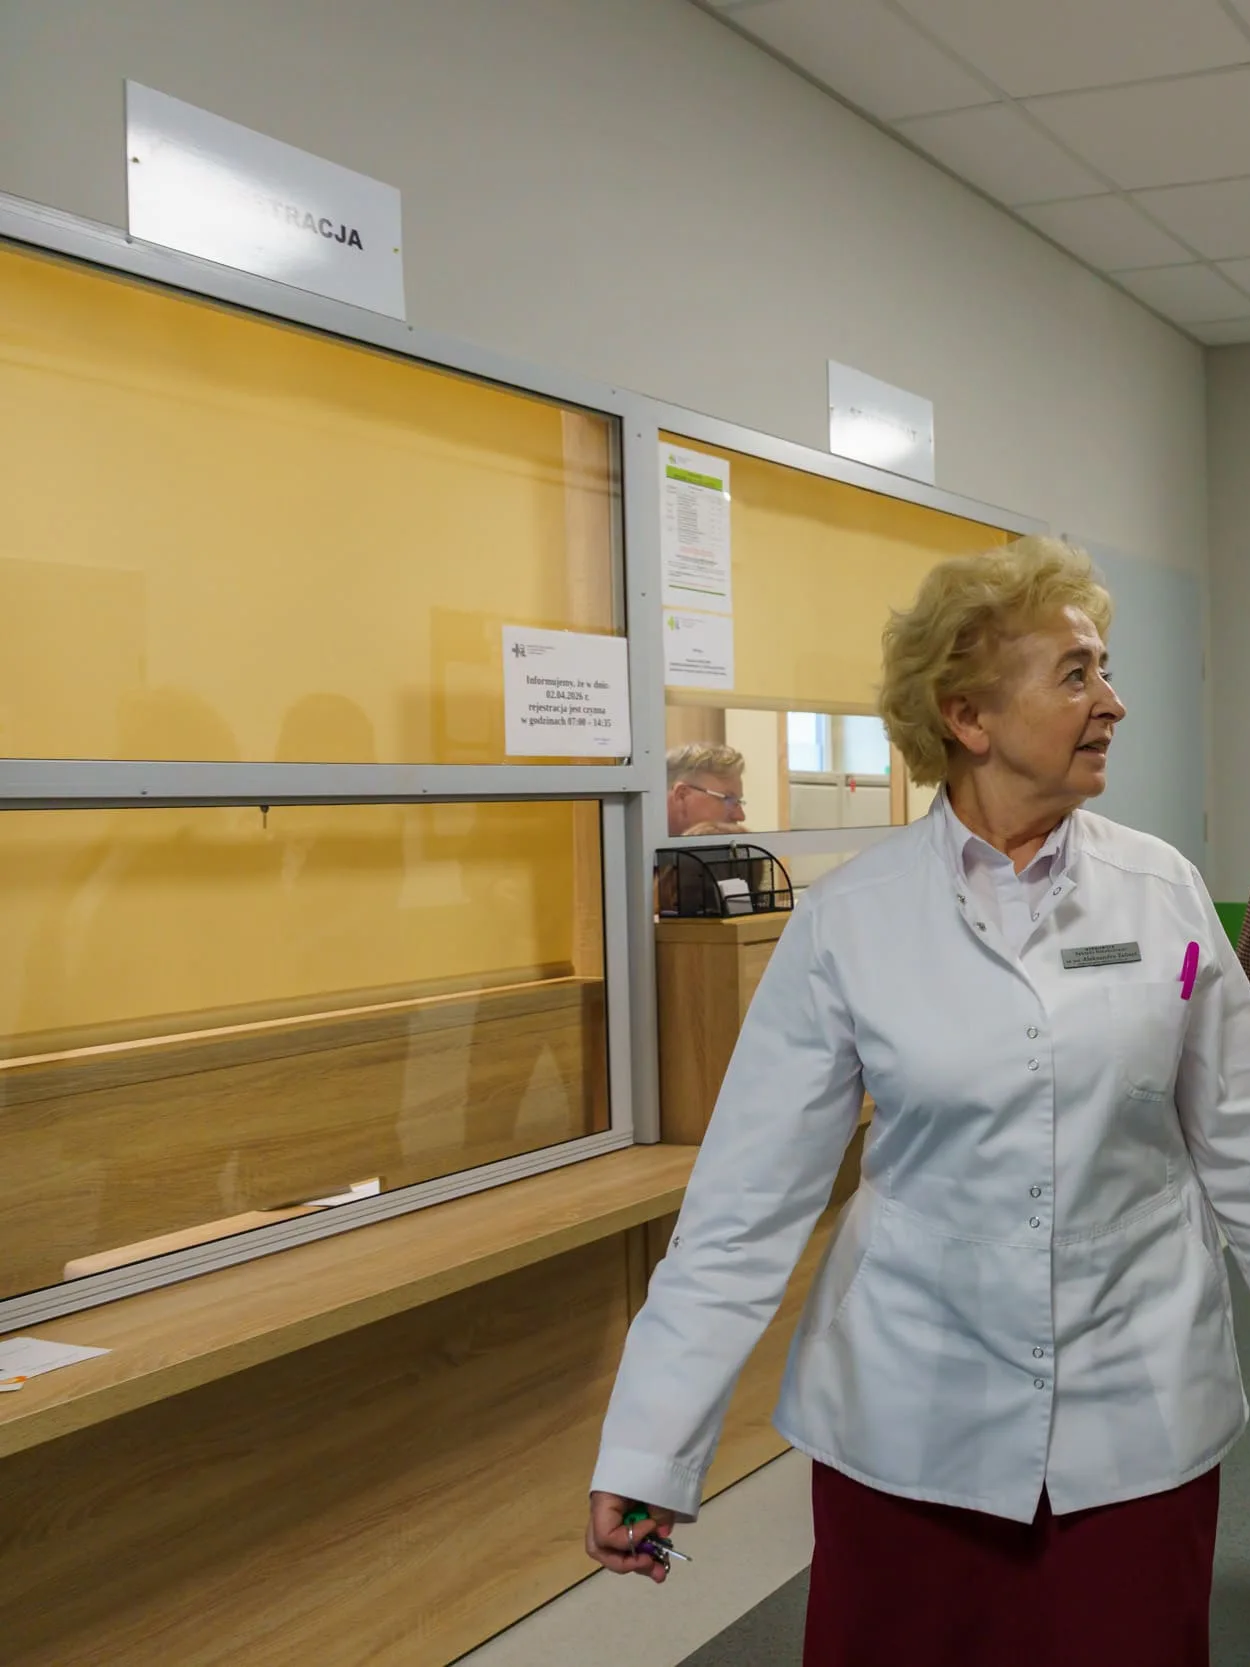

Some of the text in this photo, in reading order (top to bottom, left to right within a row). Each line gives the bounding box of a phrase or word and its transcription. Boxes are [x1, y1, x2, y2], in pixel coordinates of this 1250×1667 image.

[526, 675, 576, 689] Informujemy,
[528, 702, 606, 716] rejestracja jest czynna
[529, 715, 567, 726] godzinach
